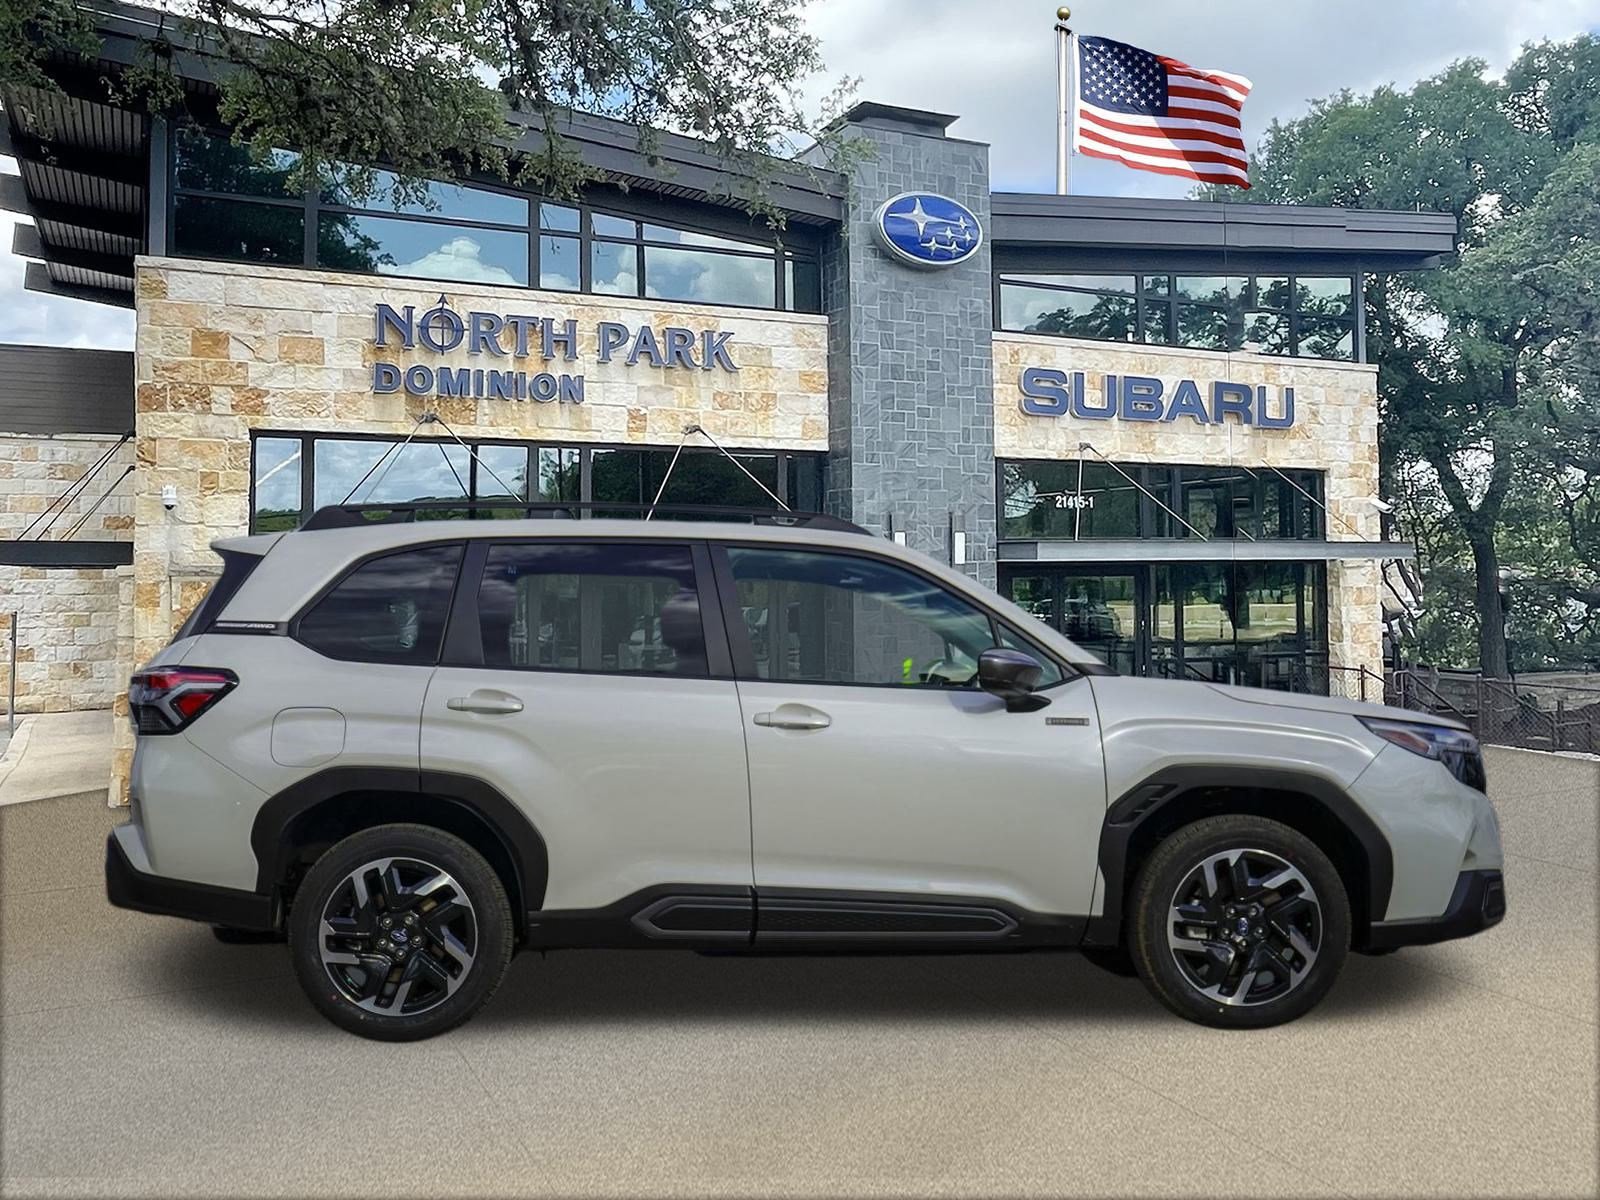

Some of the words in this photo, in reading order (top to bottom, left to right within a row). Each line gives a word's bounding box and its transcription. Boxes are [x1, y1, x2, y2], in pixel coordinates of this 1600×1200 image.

[374, 294, 579, 362] NORTH
[597, 321, 742, 373] PARK
[372, 362, 585, 405] DOMINION
[1019, 367, 1294, 429] SUBARU
